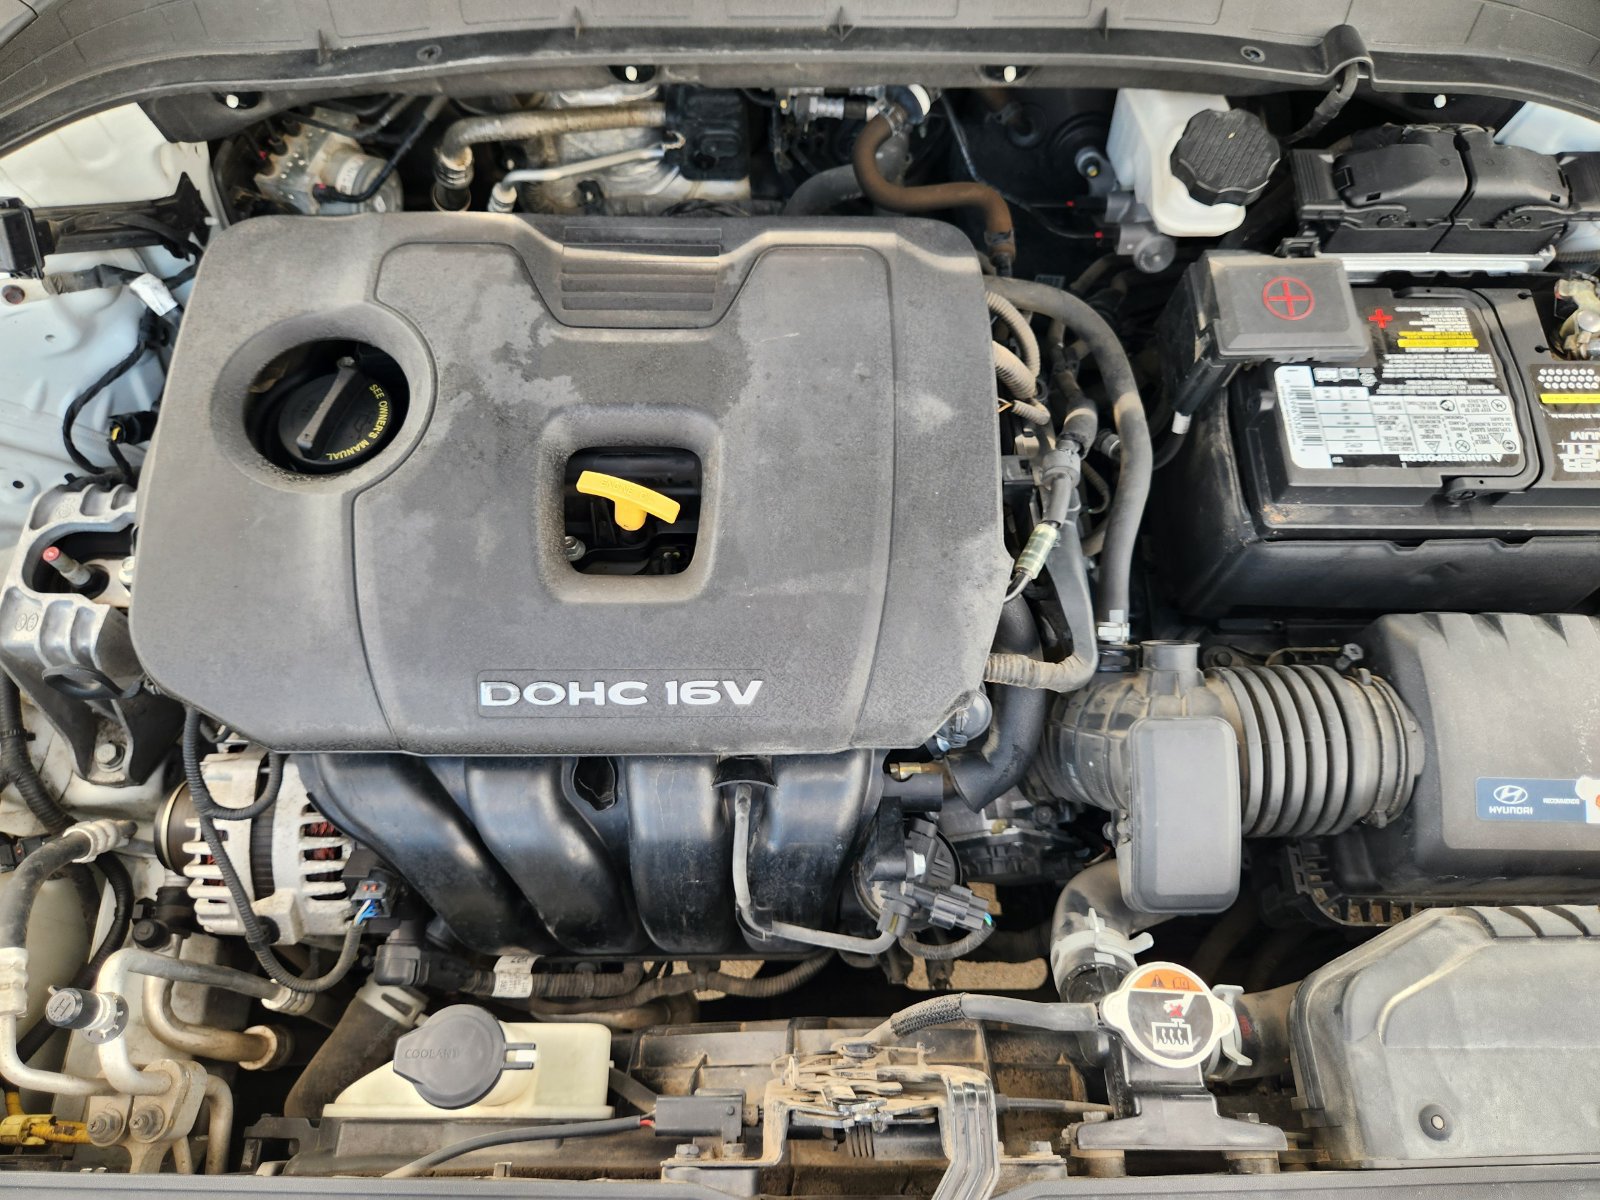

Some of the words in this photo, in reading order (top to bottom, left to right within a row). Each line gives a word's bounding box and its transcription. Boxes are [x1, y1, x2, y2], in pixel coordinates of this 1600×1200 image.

[369, 384, 385, 400] SEE
[368, 400, 389, 439] OWNER'S
[326, 439, 370, 461] MANUAL
[480, 681, 648, 706] DOHC
[665, 680, 764, 706] 16V
[1489, 806, 1534, 815] HYUNDAI
